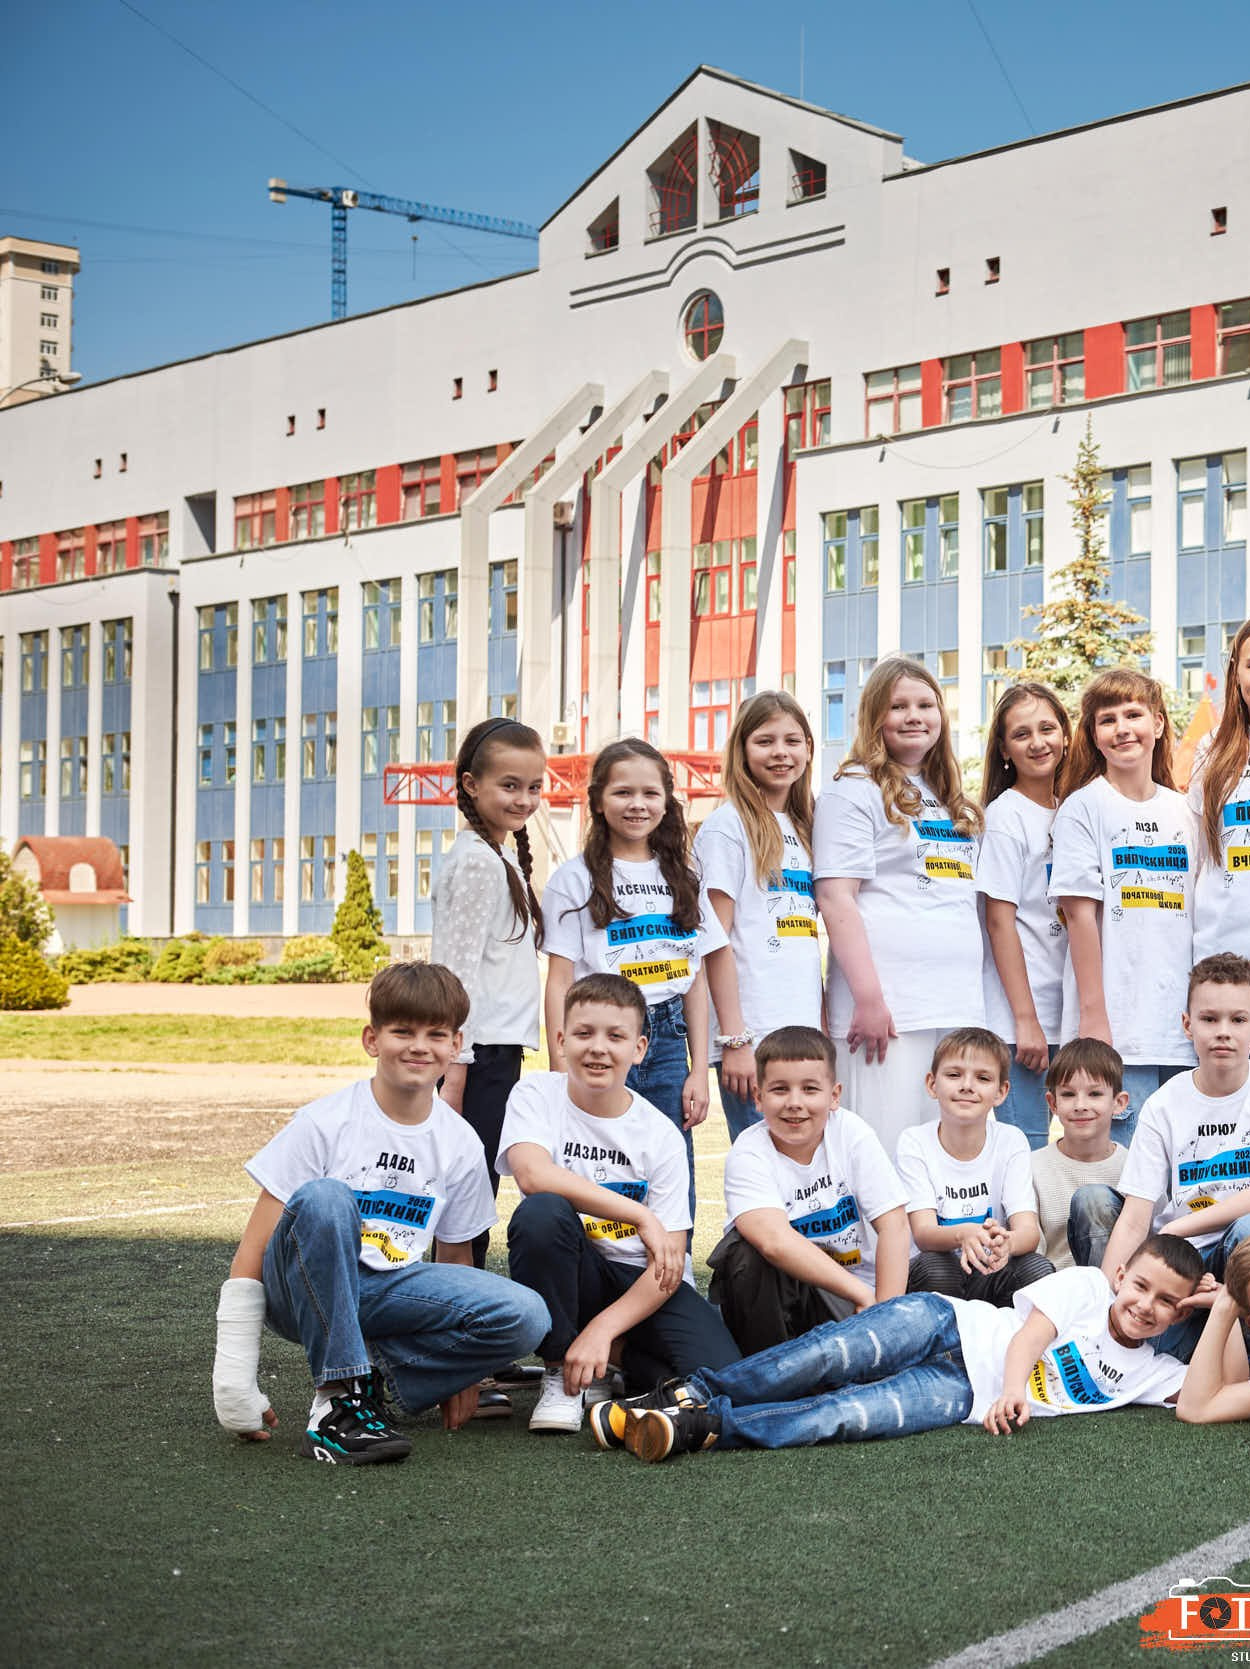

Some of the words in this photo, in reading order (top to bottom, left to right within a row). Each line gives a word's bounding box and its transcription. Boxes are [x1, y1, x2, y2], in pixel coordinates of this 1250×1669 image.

[1115, 853, 1188, 869] ВИПУСКНИЦЯ
[1158, 901, 1183, 911] ШКОЛИ
[376, 1152, 415, 1175] ДАВА
